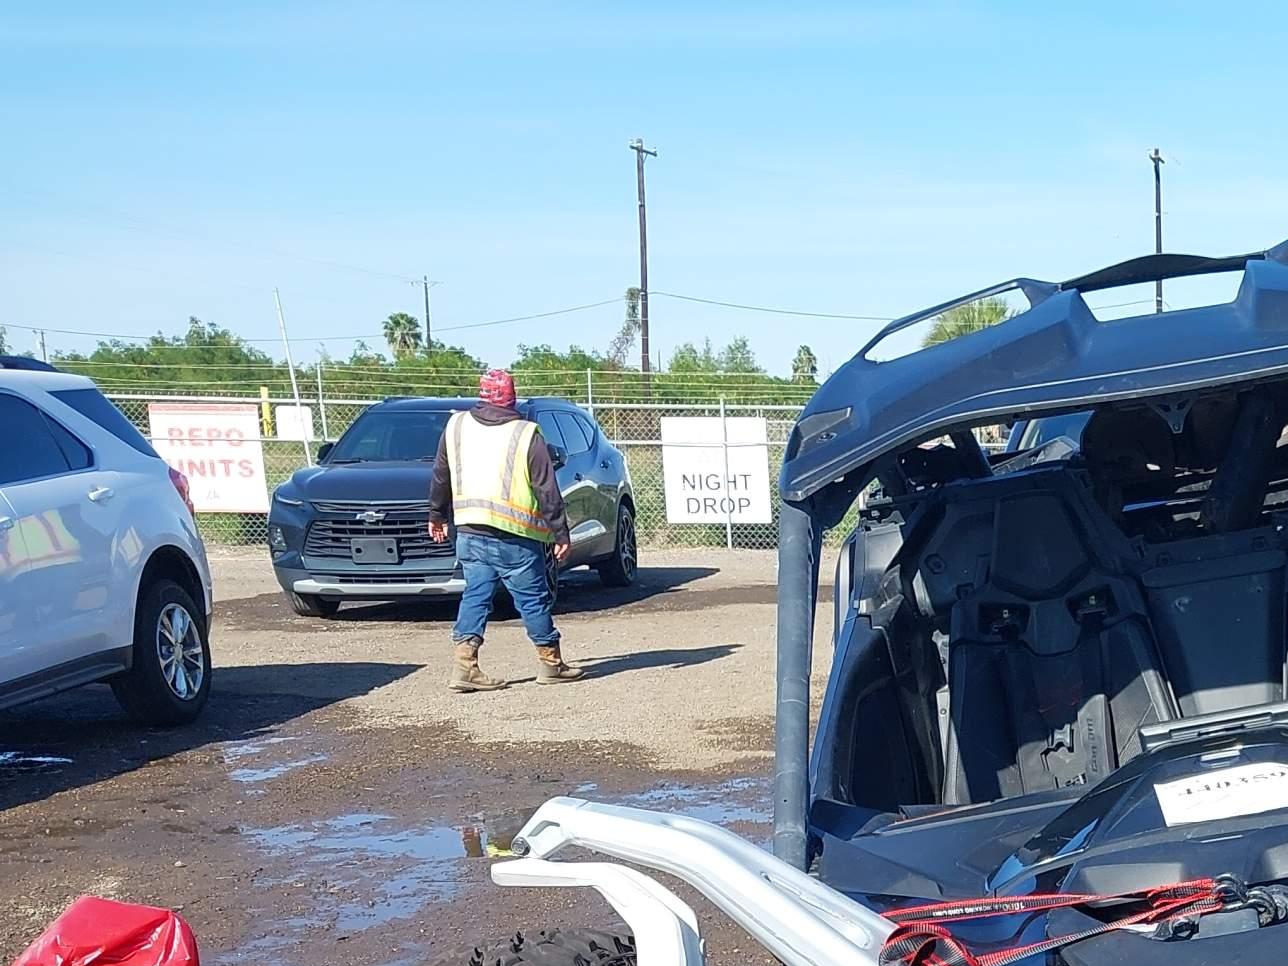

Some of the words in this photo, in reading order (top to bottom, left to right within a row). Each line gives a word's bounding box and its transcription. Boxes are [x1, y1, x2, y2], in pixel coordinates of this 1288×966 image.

[167, 426, 244, 447] REPO
[681, 473, 752, 491] NIGHT
[686, 497, 751, 514] DROP
